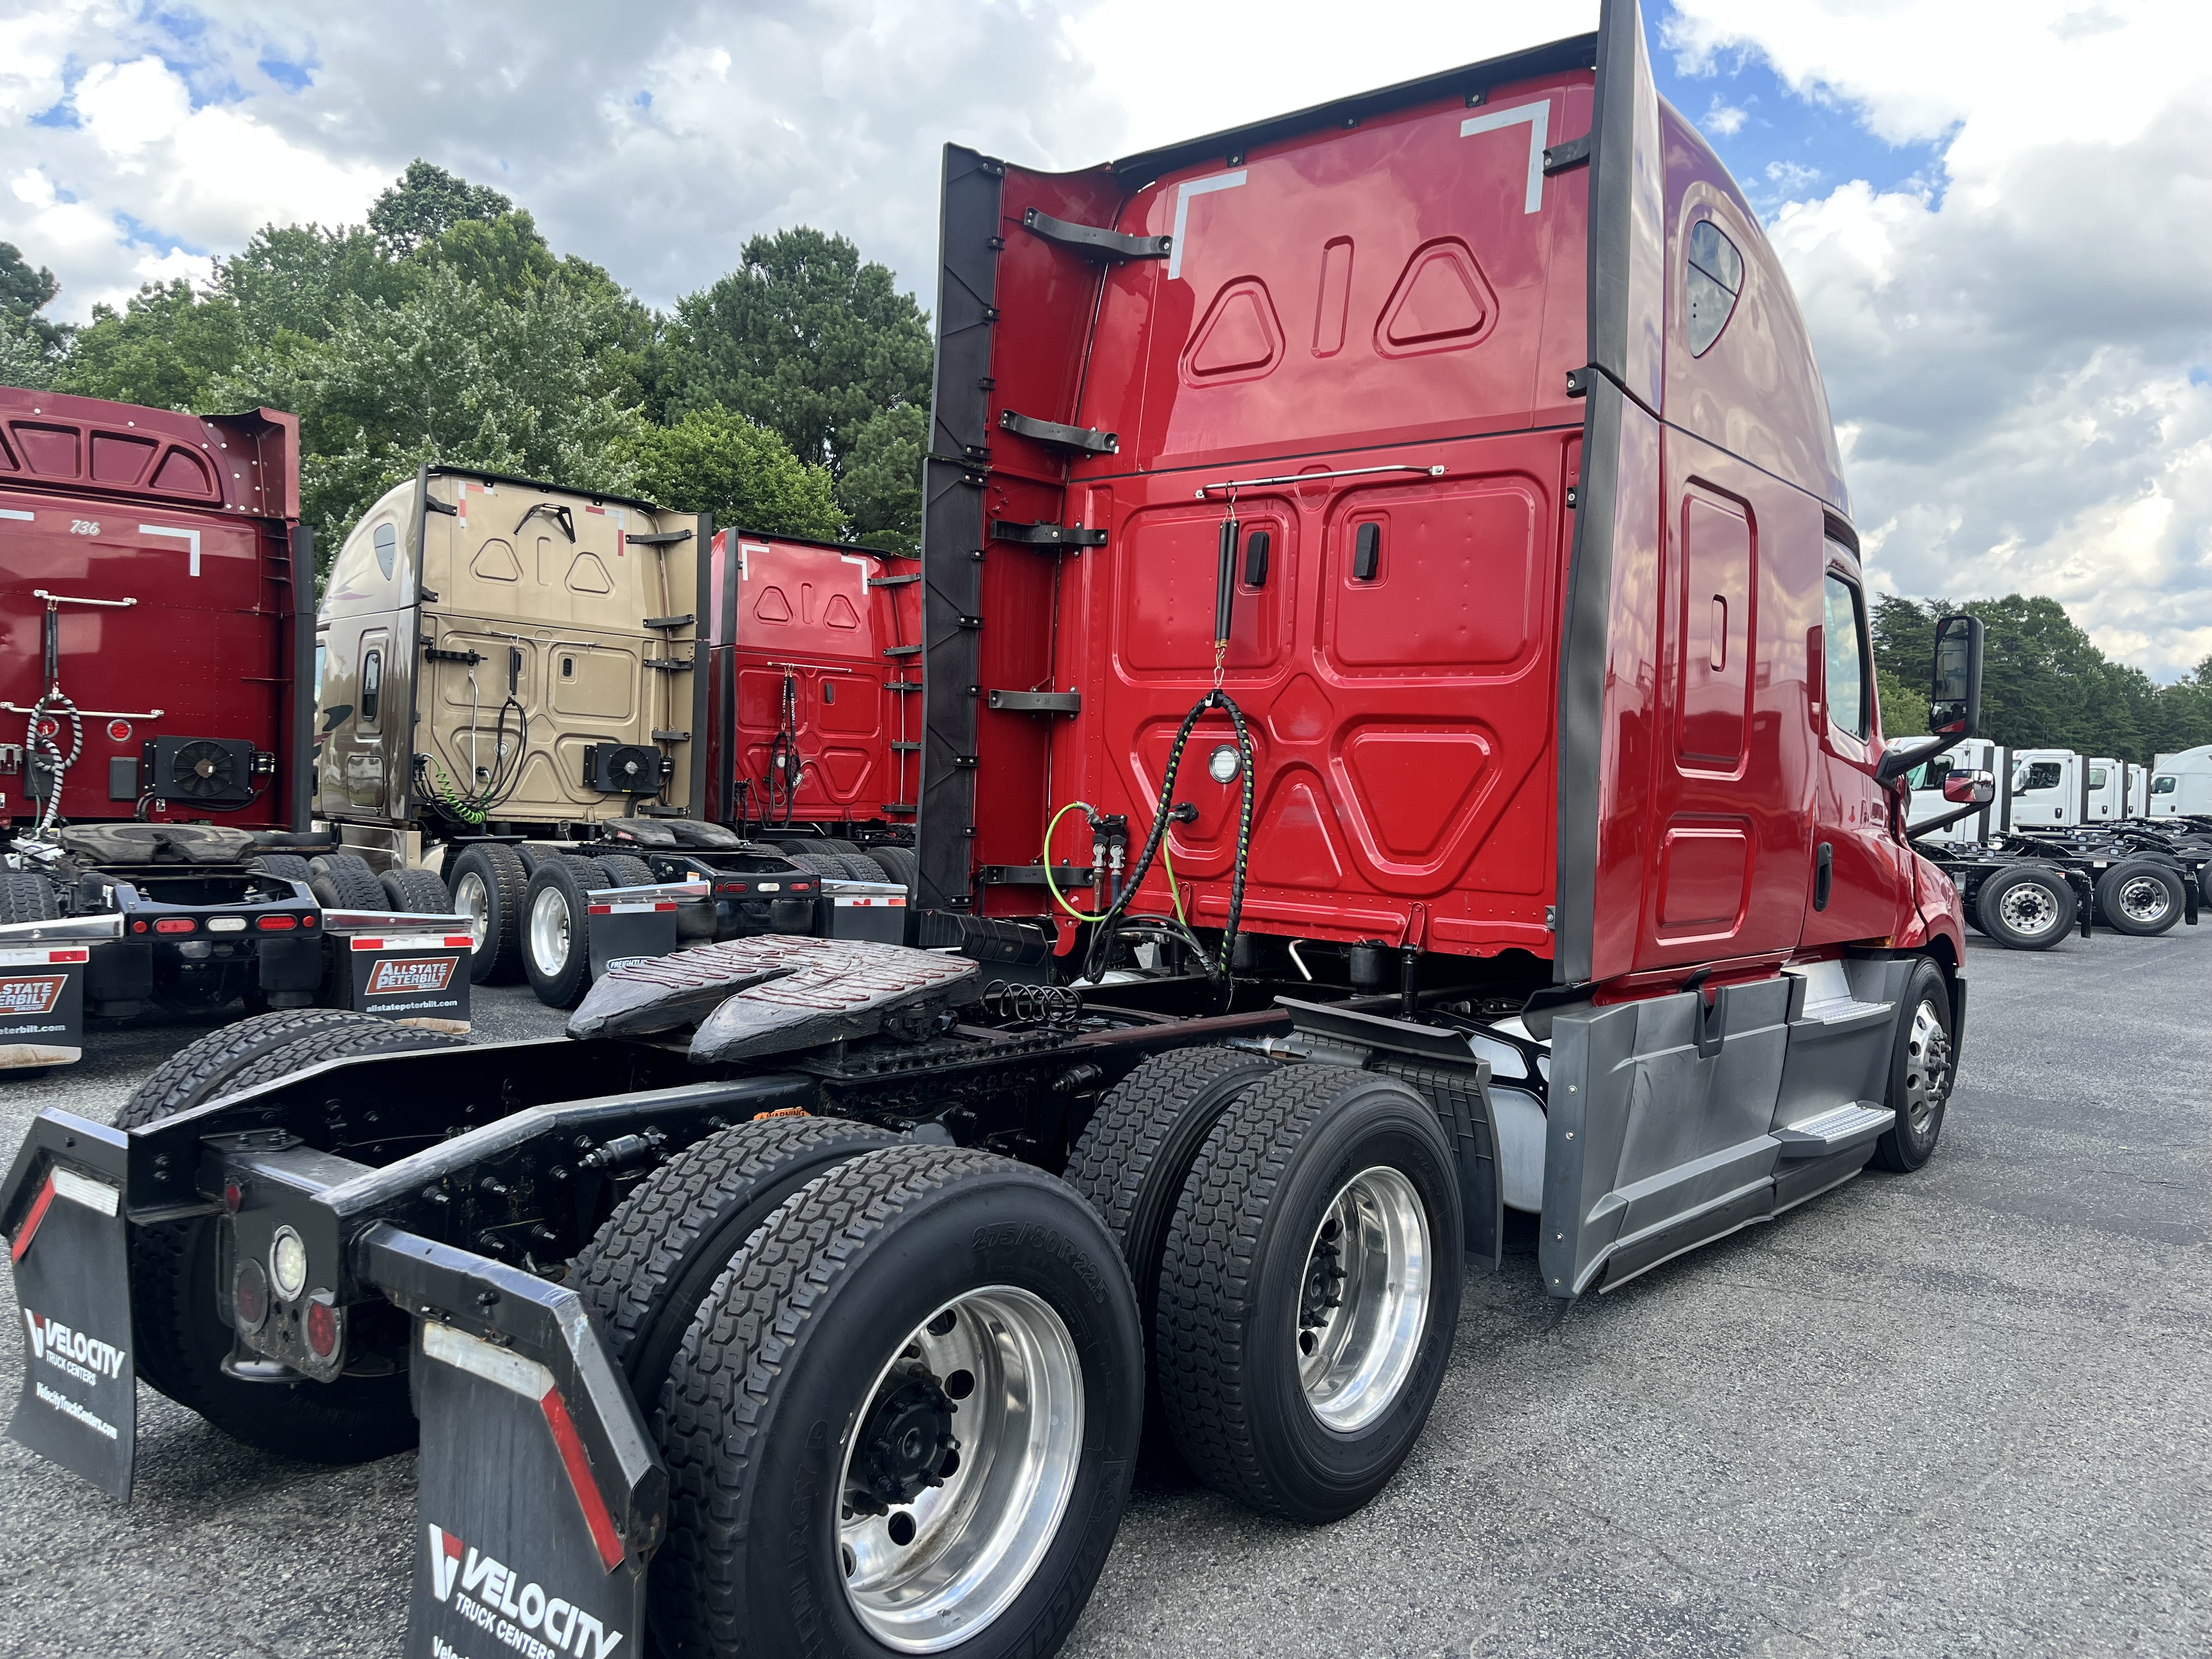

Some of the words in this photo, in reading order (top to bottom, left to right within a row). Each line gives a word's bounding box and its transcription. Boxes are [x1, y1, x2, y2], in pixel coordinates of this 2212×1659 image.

[70, 519, 100, 536] 736
[379, 962, 448, 976] ALLSTATE
[0, 982, 54, 996] STATE
[376, 973, 445, 990] PETERBILT
[366, 1000, 458, 1013] allstatepeterbilt.com
[44, 1317, 126, 1380] VELOCITY
[46, 1349, 67, 1371] TRUCK
[66, 1360, 98, 1387] CENTERS
[460, 1546, 624, 1659] VELOCITY
[455, 1592, 498, 1634] TRUCK
[496, 1618, 556, 1659] CENTERS
